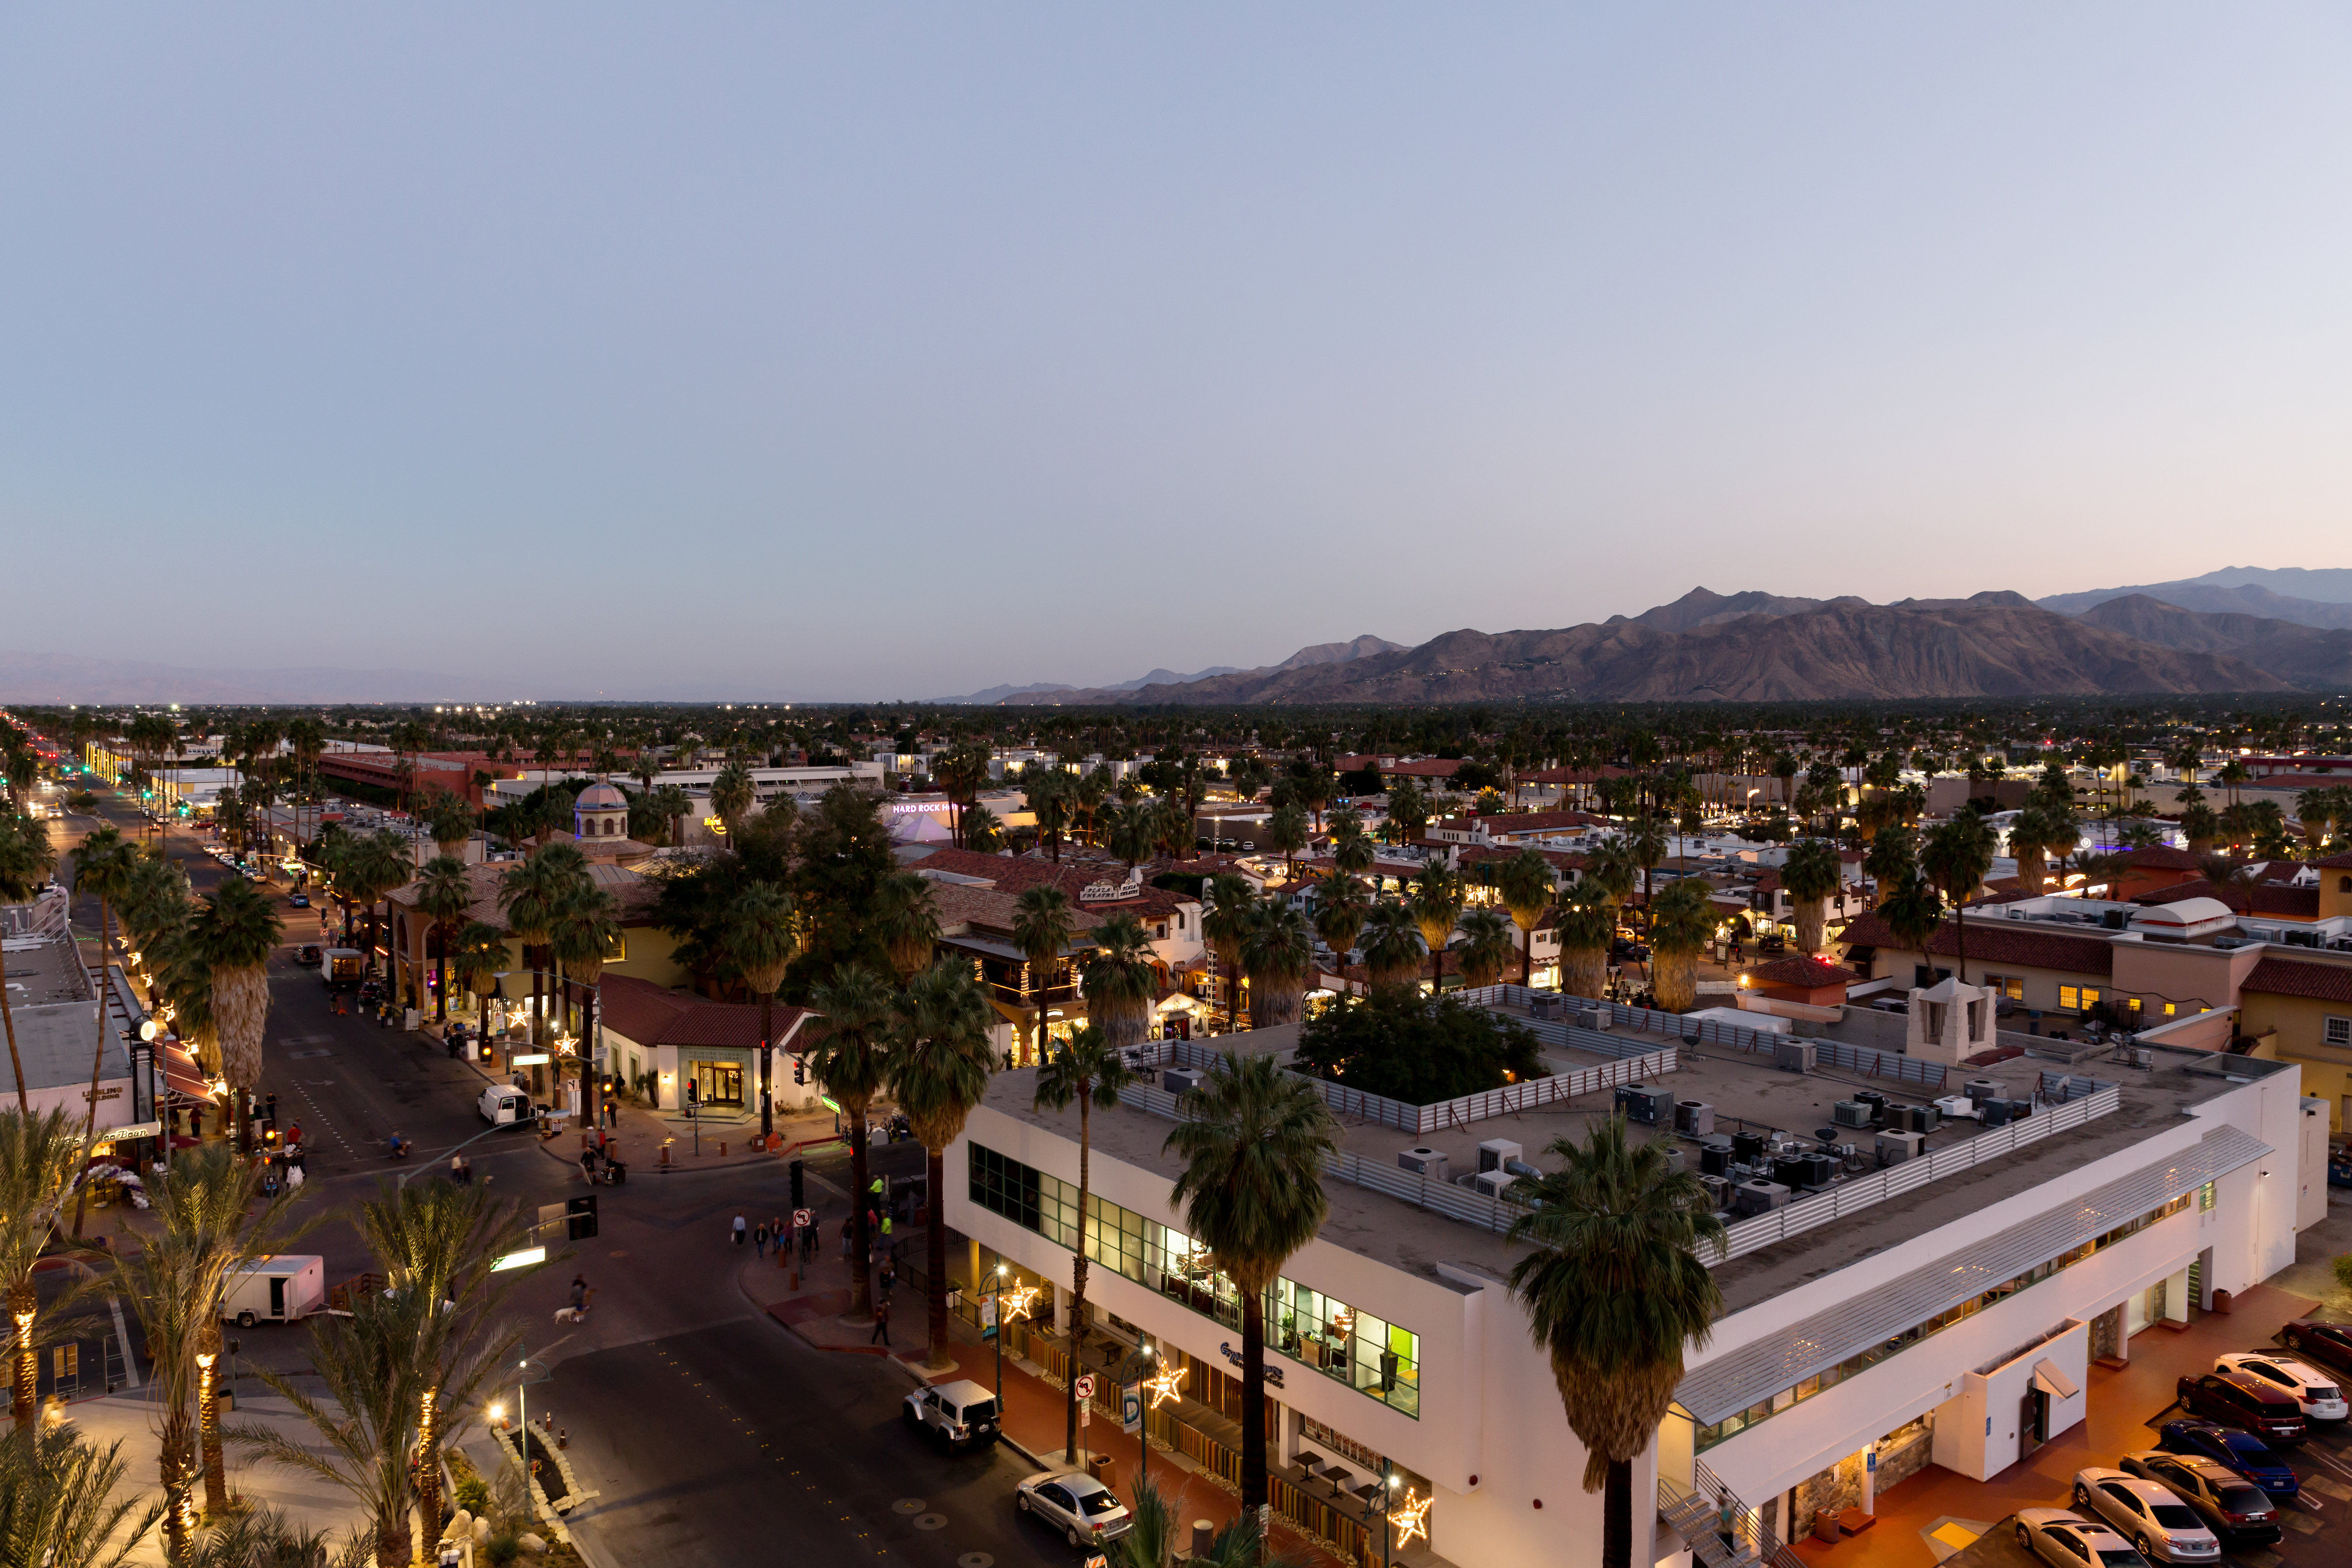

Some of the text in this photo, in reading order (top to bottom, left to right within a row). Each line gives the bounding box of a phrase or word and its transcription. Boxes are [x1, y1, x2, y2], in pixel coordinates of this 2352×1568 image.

[893, 805, 917, 813] HARD
[918, 804, 940, 812] ROCK
[117, 1129, 148, 1139] Bean
